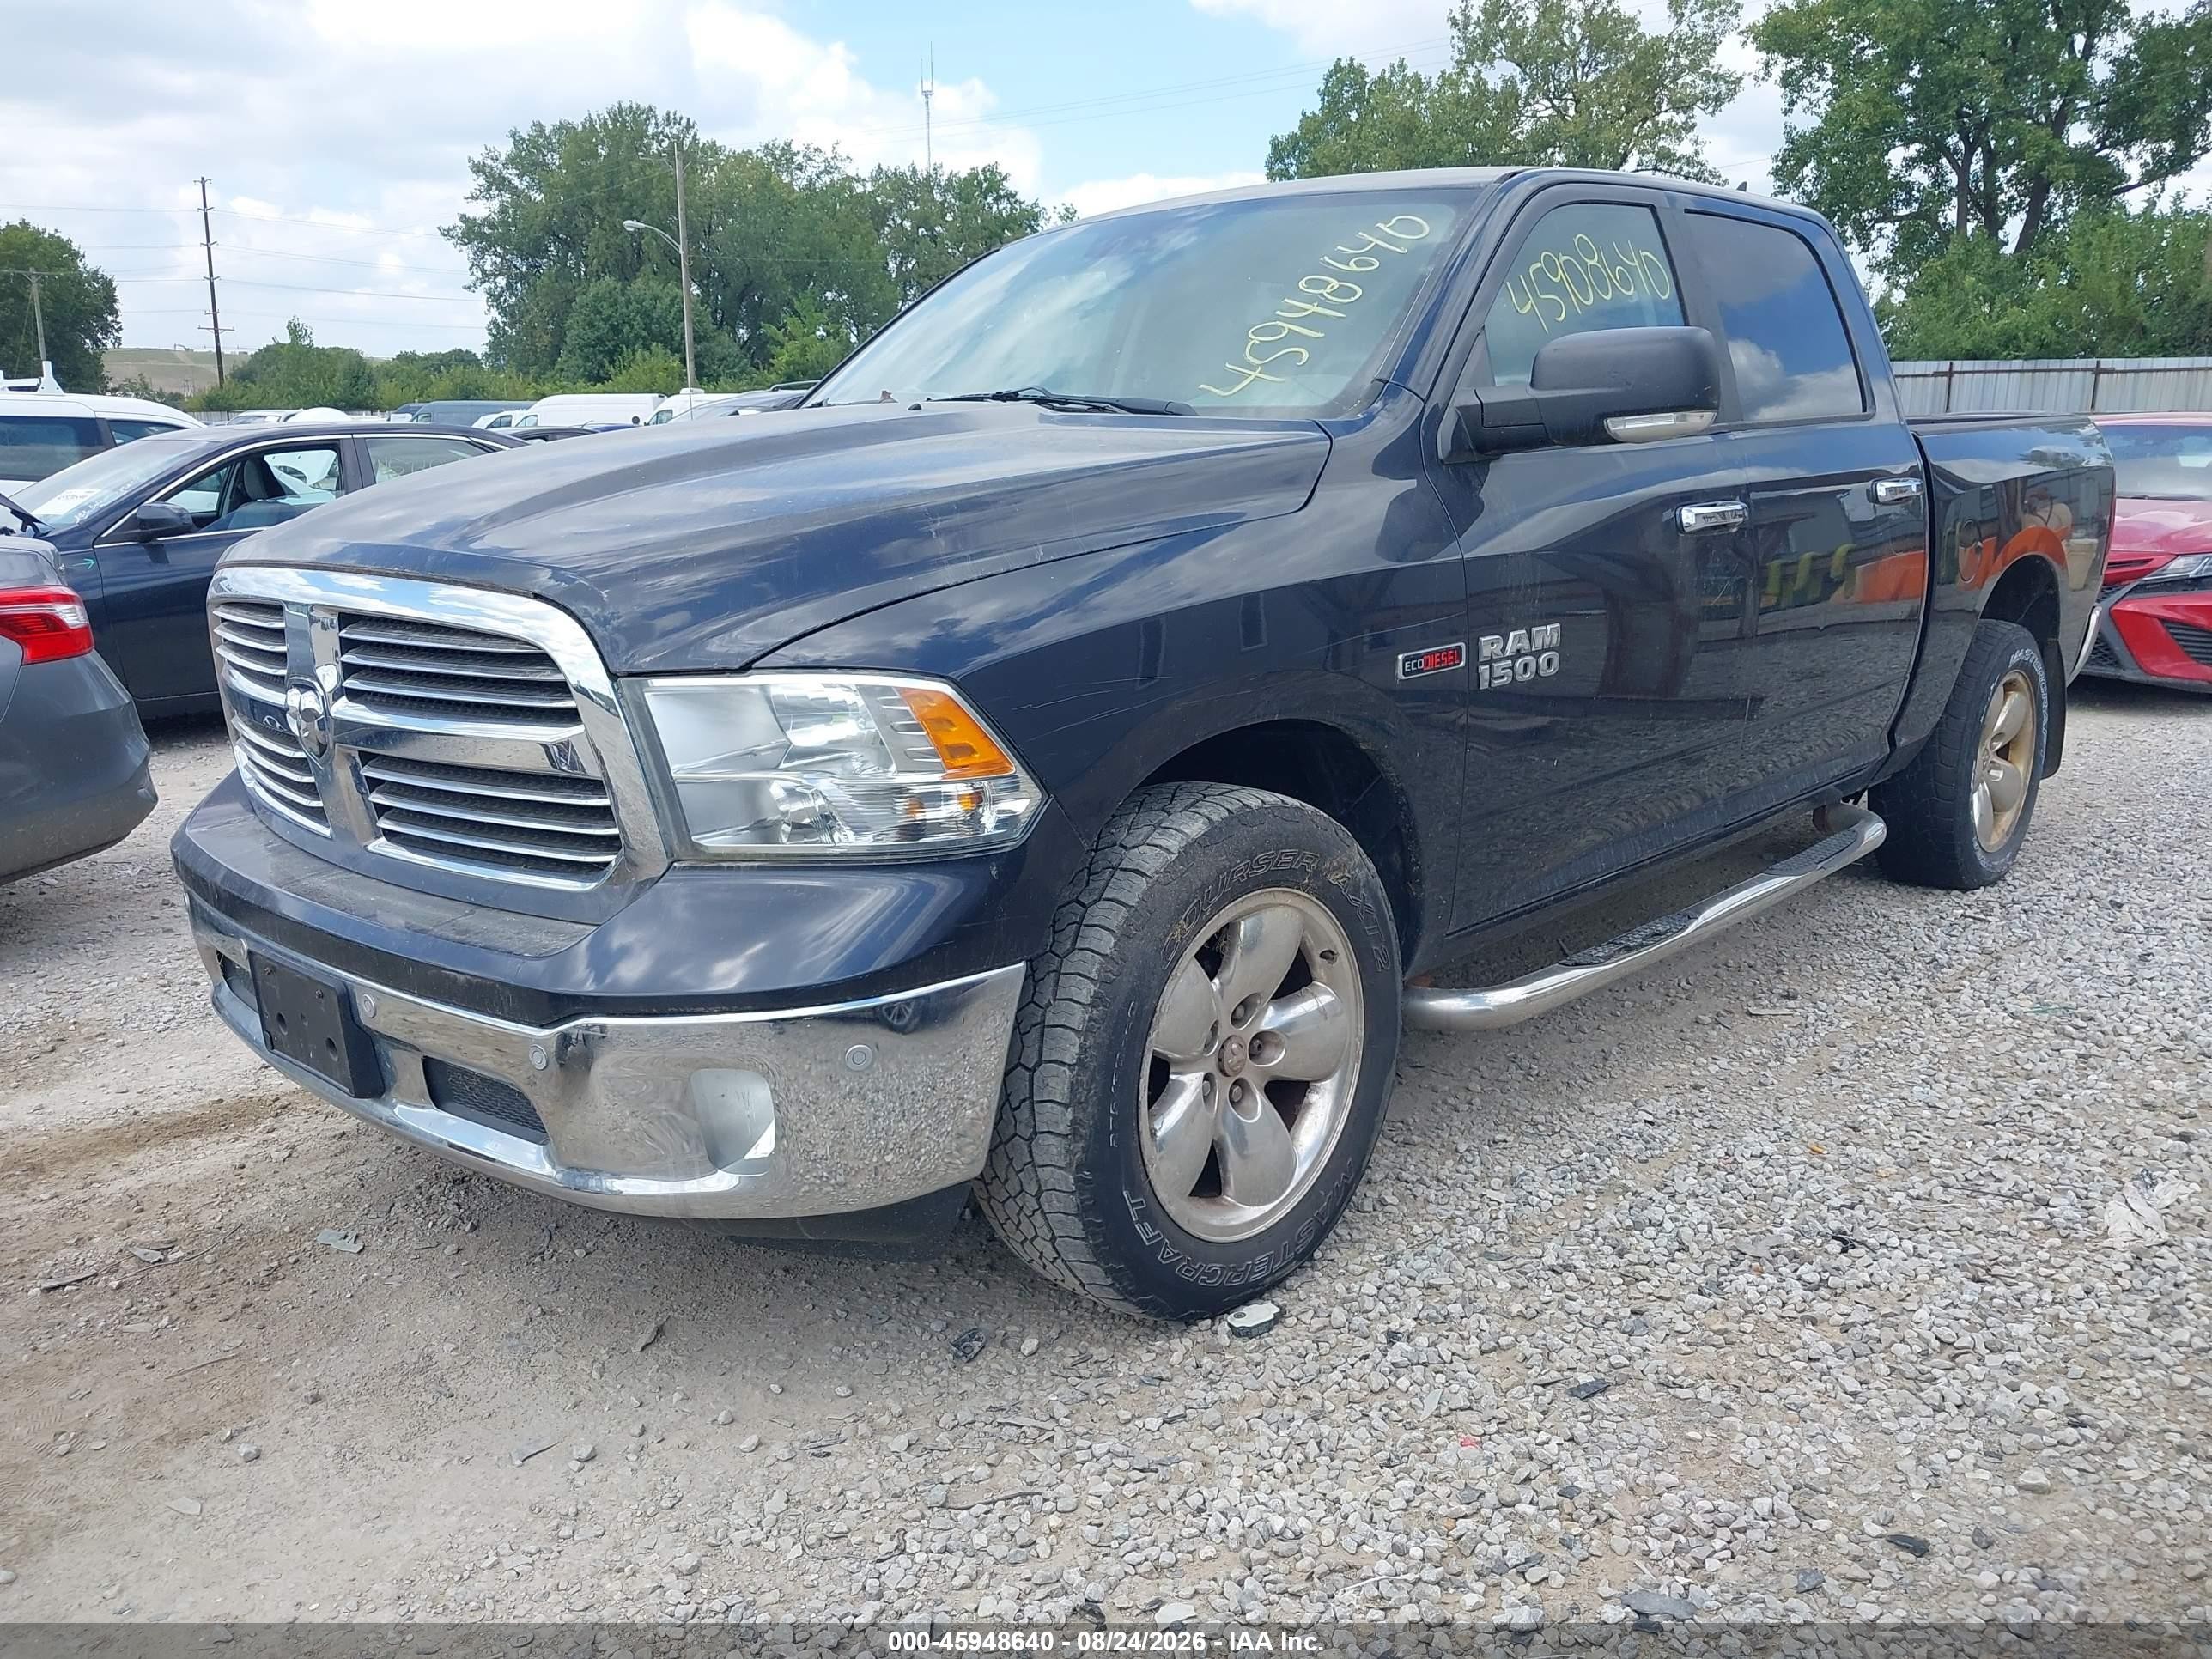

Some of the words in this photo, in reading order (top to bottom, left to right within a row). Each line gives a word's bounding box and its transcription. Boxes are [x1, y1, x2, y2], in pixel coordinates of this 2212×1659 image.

[1200, 214, 1431, 398] 45948640
[1404, 649, 1461, 672] ECODIESEL
[1478, 623, 1561, 662] RAM
[1478, 651, 1560, 690] 1500
[1161, 848, 1319, 970] COURSER
[1122, 1156, 1354, 1286] MASTERCRAFT
